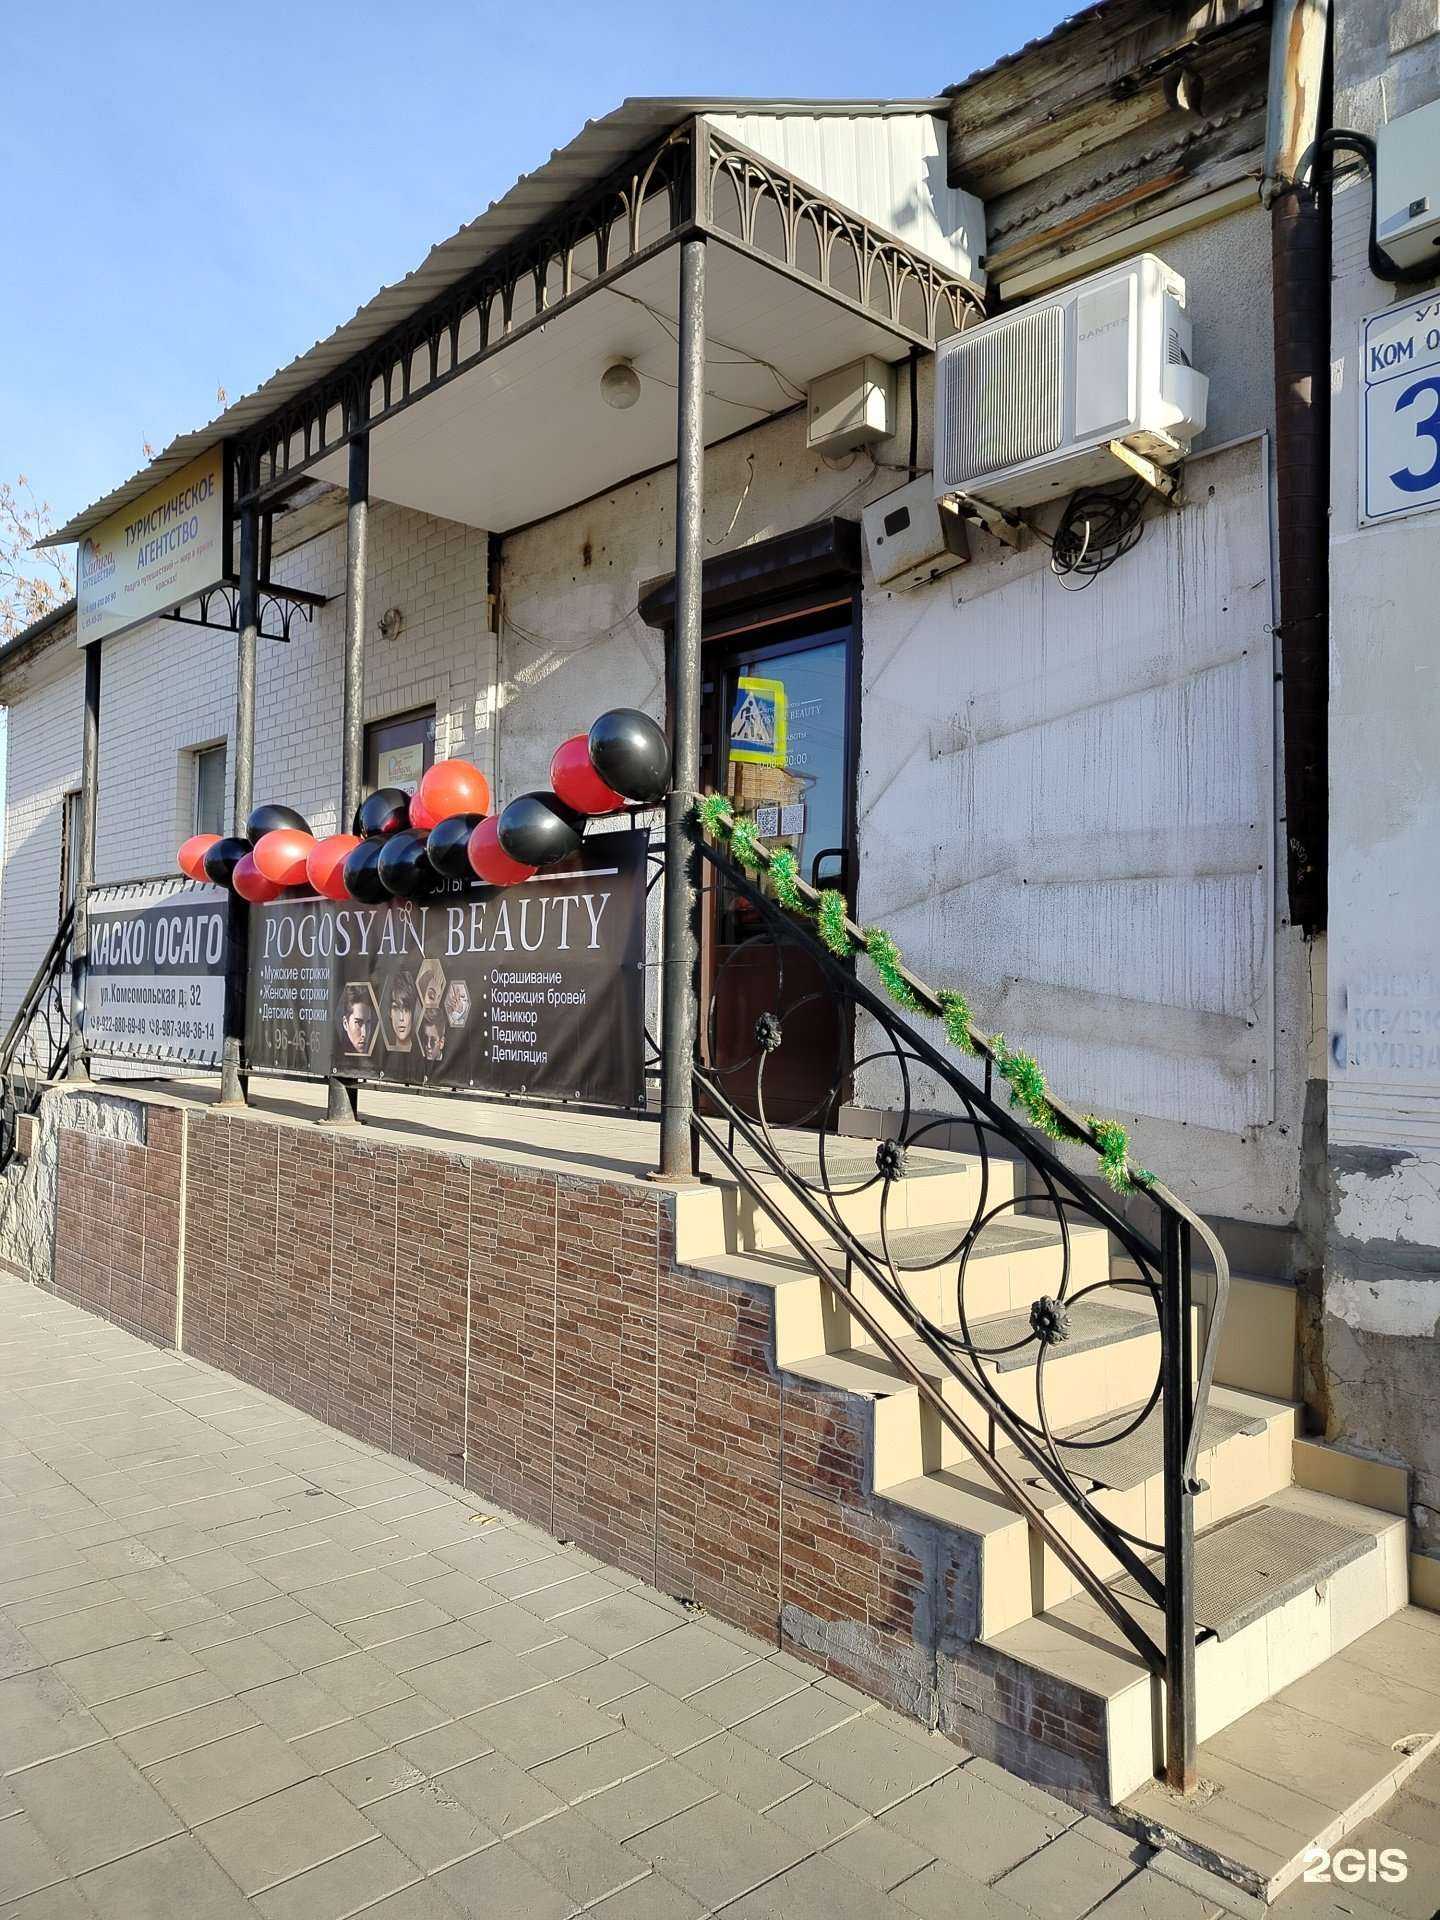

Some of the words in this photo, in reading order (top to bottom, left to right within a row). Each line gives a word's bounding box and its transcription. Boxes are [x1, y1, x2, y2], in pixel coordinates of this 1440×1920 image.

[124, 473, 215, 547] ТУРИСТИЧЕСКОЕ
[137, 515, 199, 570] АГЕНТСТВО
[790, 705, 822, 721] BEAUTY
[262, 906, 430, 959] POGOSYAN
[445, 893, 611, 956] BEAUTY
[90, 919, 146, 966] КАСКО
[154, 913, 224, 965] ОСАГО
[264, 964, 299, 984] Мужские
[300, 967, 330, 984] стрижки
[491, 969, 562, 987] Окрашивание
[190, 984, 201, 1006] 32
[262, 984, 298, 1000] Женские
[300, 988, 329, 1005] стрижки
[491, 988, 544, 1007] Коррекция
[547, 987, 586, 1007] бровей
[262, 1003, 294, 1021] Детские
[491, 1007, 538, 1026] Маникюр
[155, 1018, 215, 1040] 8-987-348-36-14
[491, 1026, 537, 1046] Педикюр
[491, 1045, 548, 1065] Депиляция
